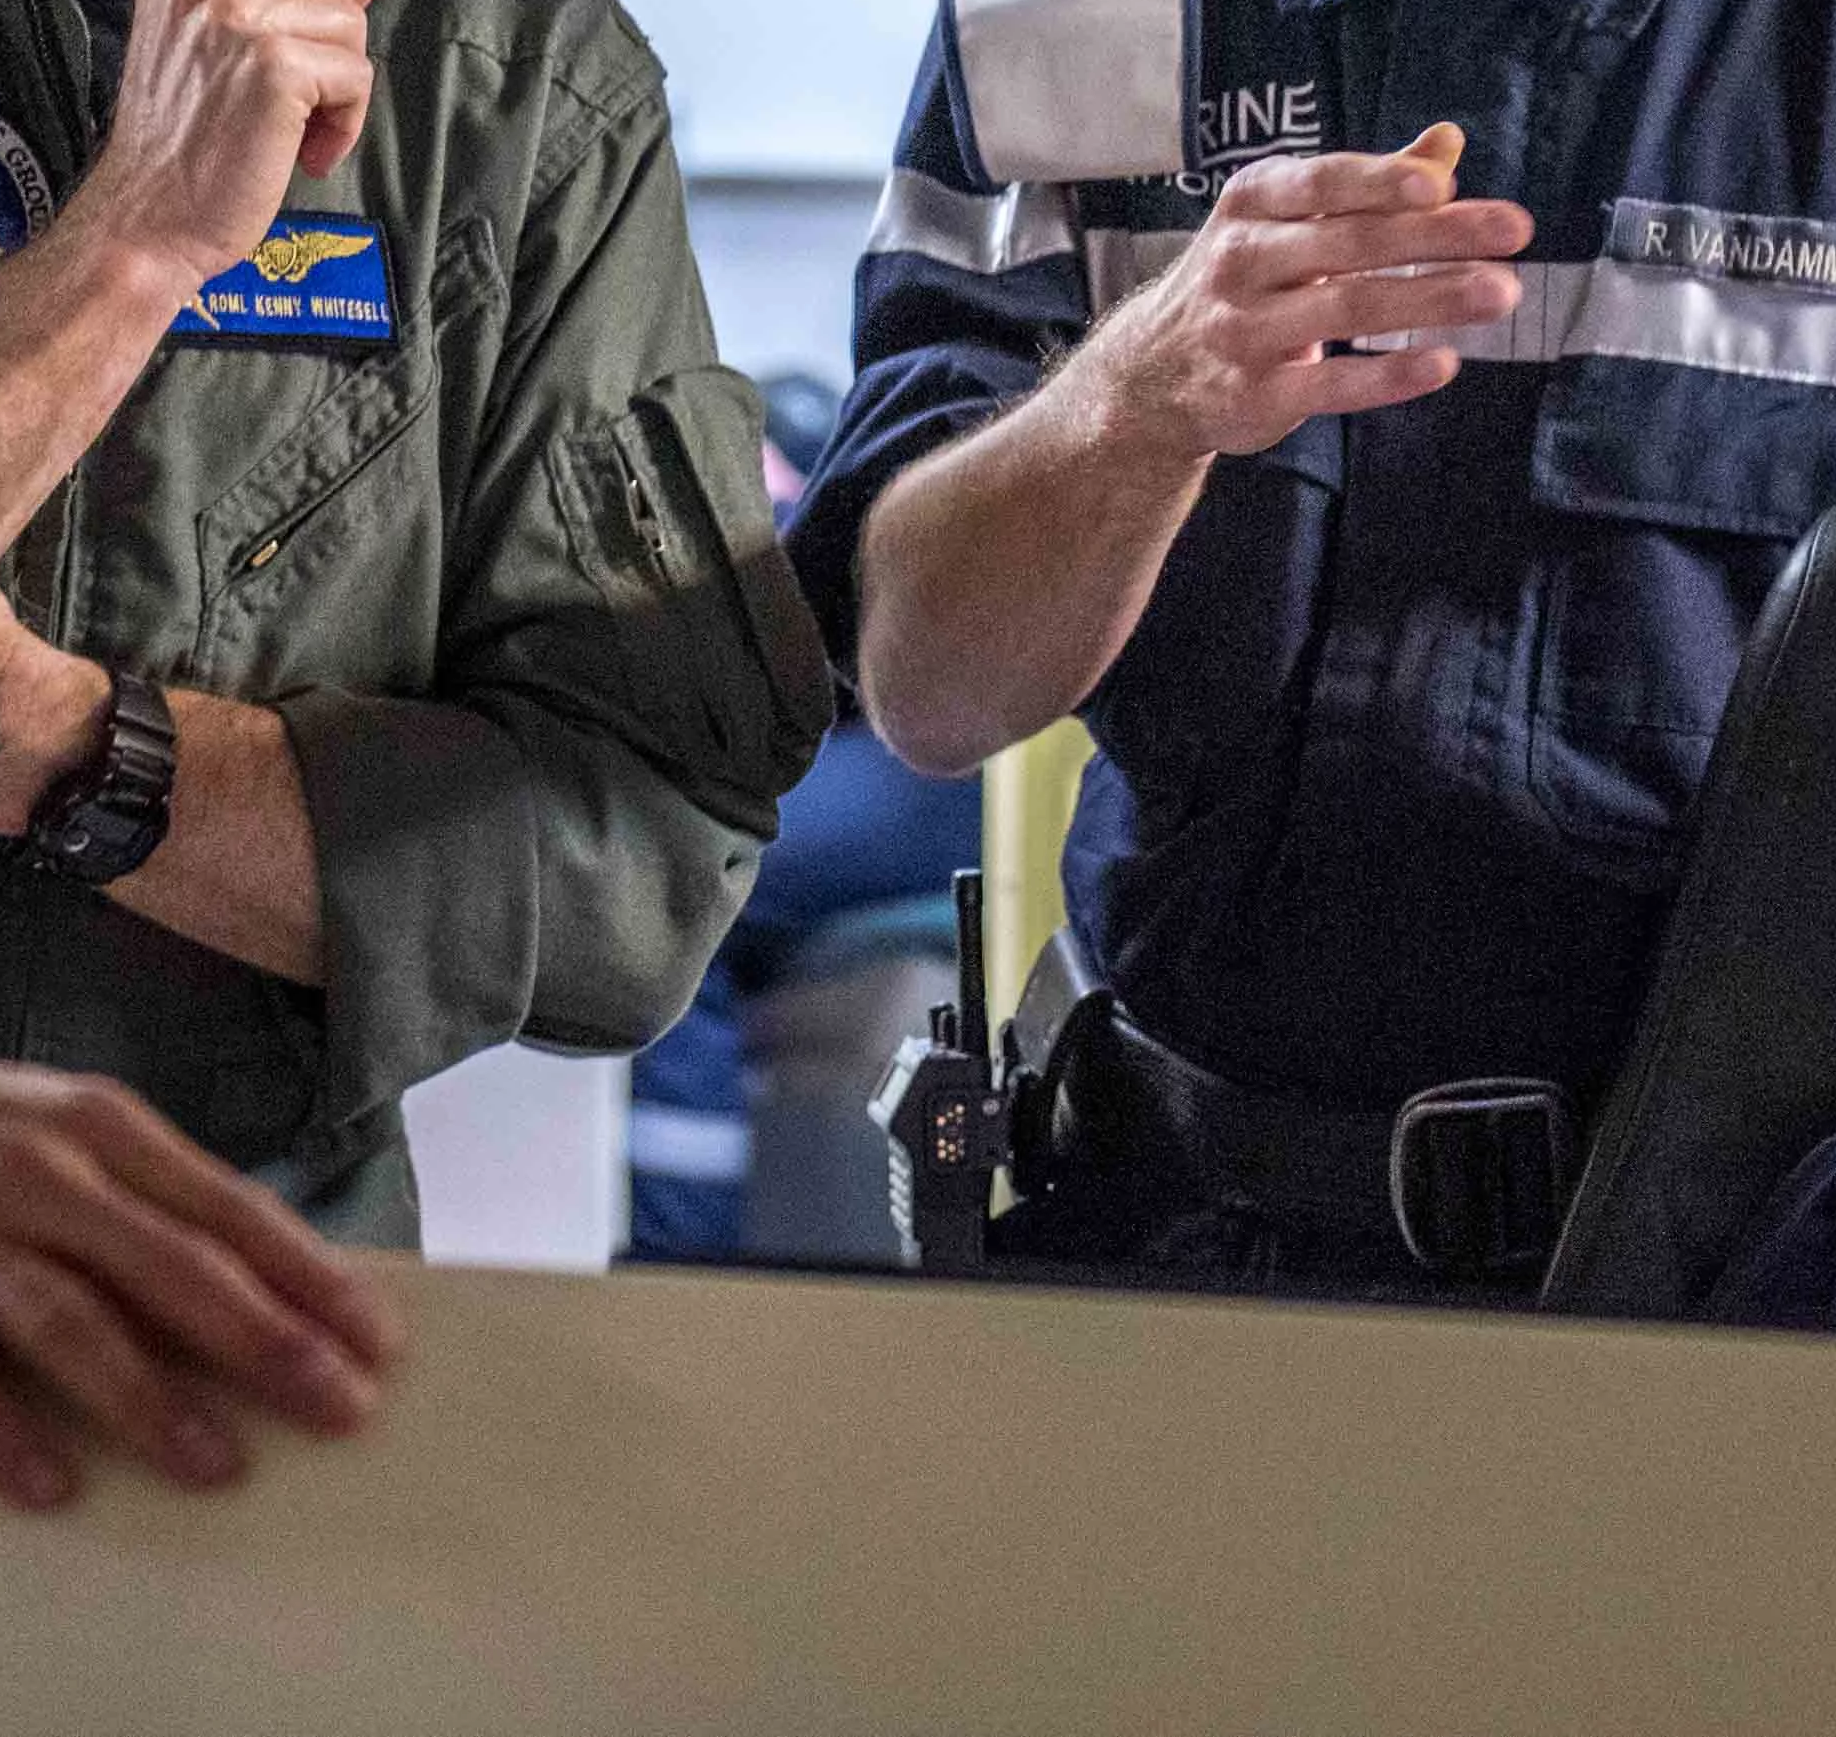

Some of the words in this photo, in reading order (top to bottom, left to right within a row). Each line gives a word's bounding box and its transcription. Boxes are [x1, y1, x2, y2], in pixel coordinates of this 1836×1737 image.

[1196, 80, 1322, 158] RINE
[5, 148, 52, 232] GROU
[1644, 220, 1673, 258] R.
[254, 293, 302, 318] KENNY
[310, 295, 390, 324] WHITESELL
